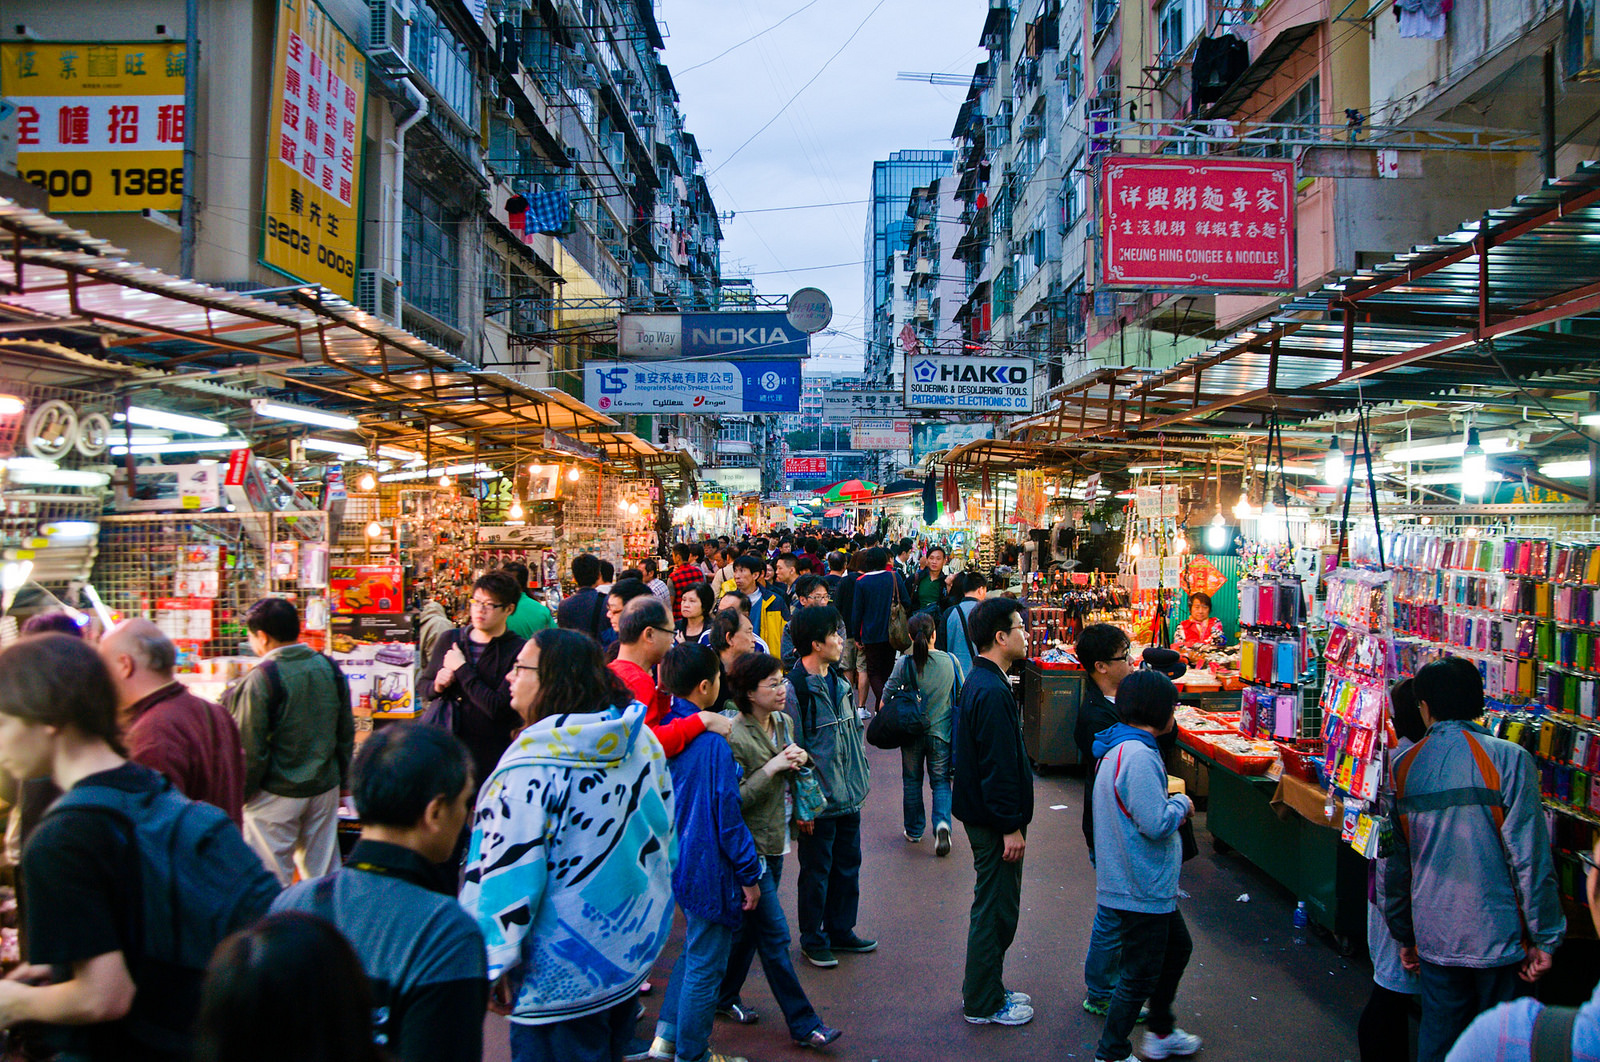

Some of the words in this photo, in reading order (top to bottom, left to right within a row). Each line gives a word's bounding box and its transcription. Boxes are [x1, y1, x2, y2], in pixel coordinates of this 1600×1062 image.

[18, 104, 185, 144] 全幢招租
[1119, 185, 1279, 213] 祥興粥麵專家
[317, 244, 354, 278] 0003
[1119, 248, 1157, 261] CHEUNG
[1159, 248, 1183, 262] HING
[1185, 249, 1223, 263] CONGEE
[1226, 250, 1234, 263] &
[1235, 250, 1280, 264] NOODLES
[635, 331, 655, 345] Top
[656, 331, 675, 345] Way
[692, 327, 789, 345] NOKIA
[634, 372, 734, 384] 集安系統有限公司
[940, 364, 1028, 384] HAKKO
[911, 384, 948, 394] SOLDERING
[950, 385, 955, 393] &
[957, 385, 1003, 395] DESOLDERING
[911, 394, 955, 405] PATRONICS
[957, 395, 1012, 407] ELECTRONICS
[1014, 397, 1028, 408] CO.
